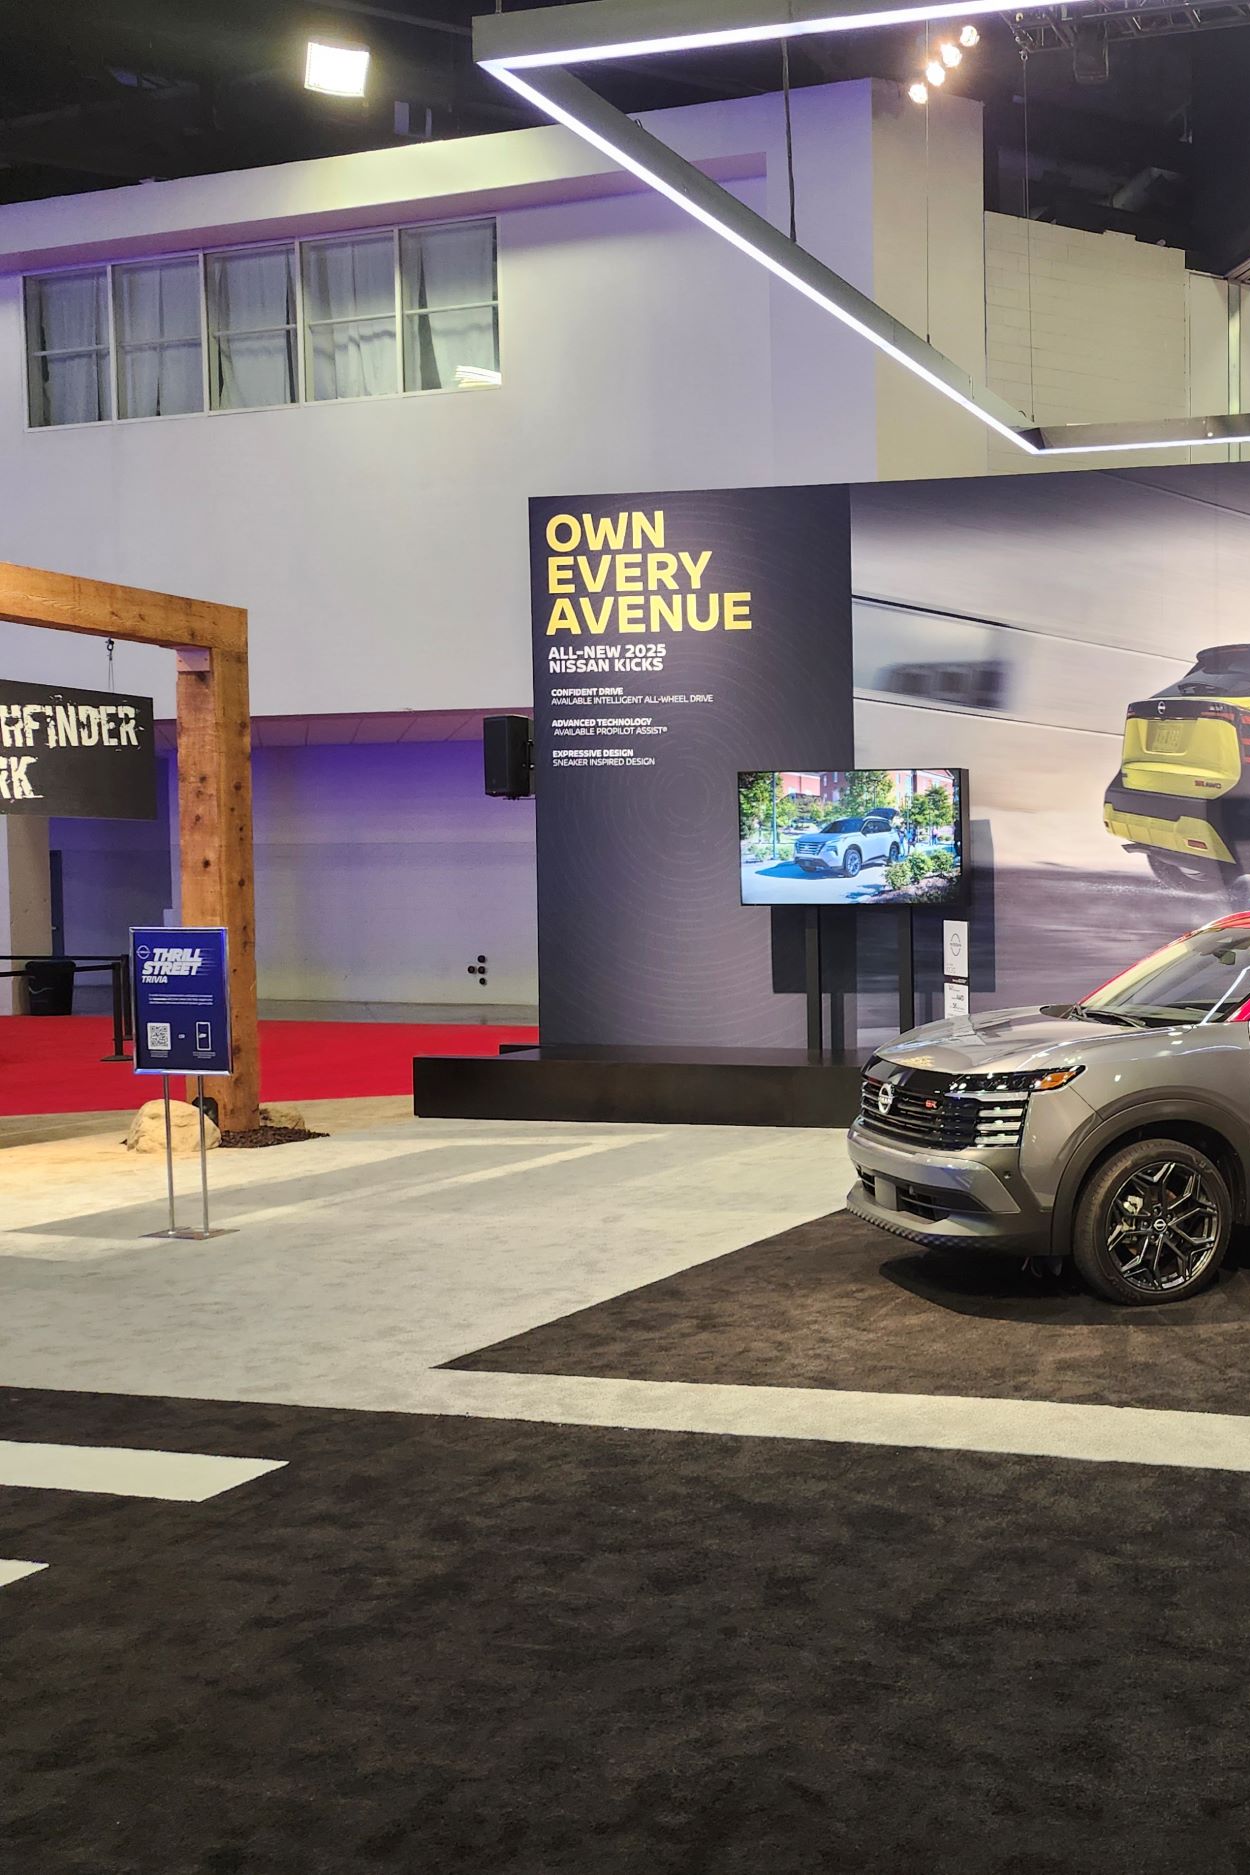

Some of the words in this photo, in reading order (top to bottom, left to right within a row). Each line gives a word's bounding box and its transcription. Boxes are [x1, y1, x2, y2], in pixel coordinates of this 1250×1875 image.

[546, 510, 665, 552] OWN
[548, 551, 712, 594] EVERY
[546, 592, 752, 635] AVENUE
[548, 645, 622, 659] ALL-NEW
[625, 643, 666, 657] 2025
[549, 659, 610, 673] NISSAN
[614, 657, 664, 672] KICKS
[551, 688, 598, 696] CONFIDENT
[599, 687, 624, 695] DRIVE
[551, 697, 592, 705] AVAILABLE
[594, 696, 643, 704] INTELLIGENT
[644, 695, 688, 703] ALL-WHEEL
[690, 694, 714, 702] DRIVE
[552, 719, 596, 727] ADVANCED
[597, 718, 652, 726] TECHNOLOGY
[554, 727, 595, 735] AVAILABLE
[596, 726, 634, 735] PROPILOT
[553, 750, 602, 758] EXPRESSIVE
[603, 749, 634, 757] DESIGN
[553, 758, 588, 766] SNEAKER
[590, 758, 625, 766] INSPIRED
[626, 757, 655, 765] DESIGN
[153, 948, 203, 961] THRILL
[142, 961, 202, 975] STREET
